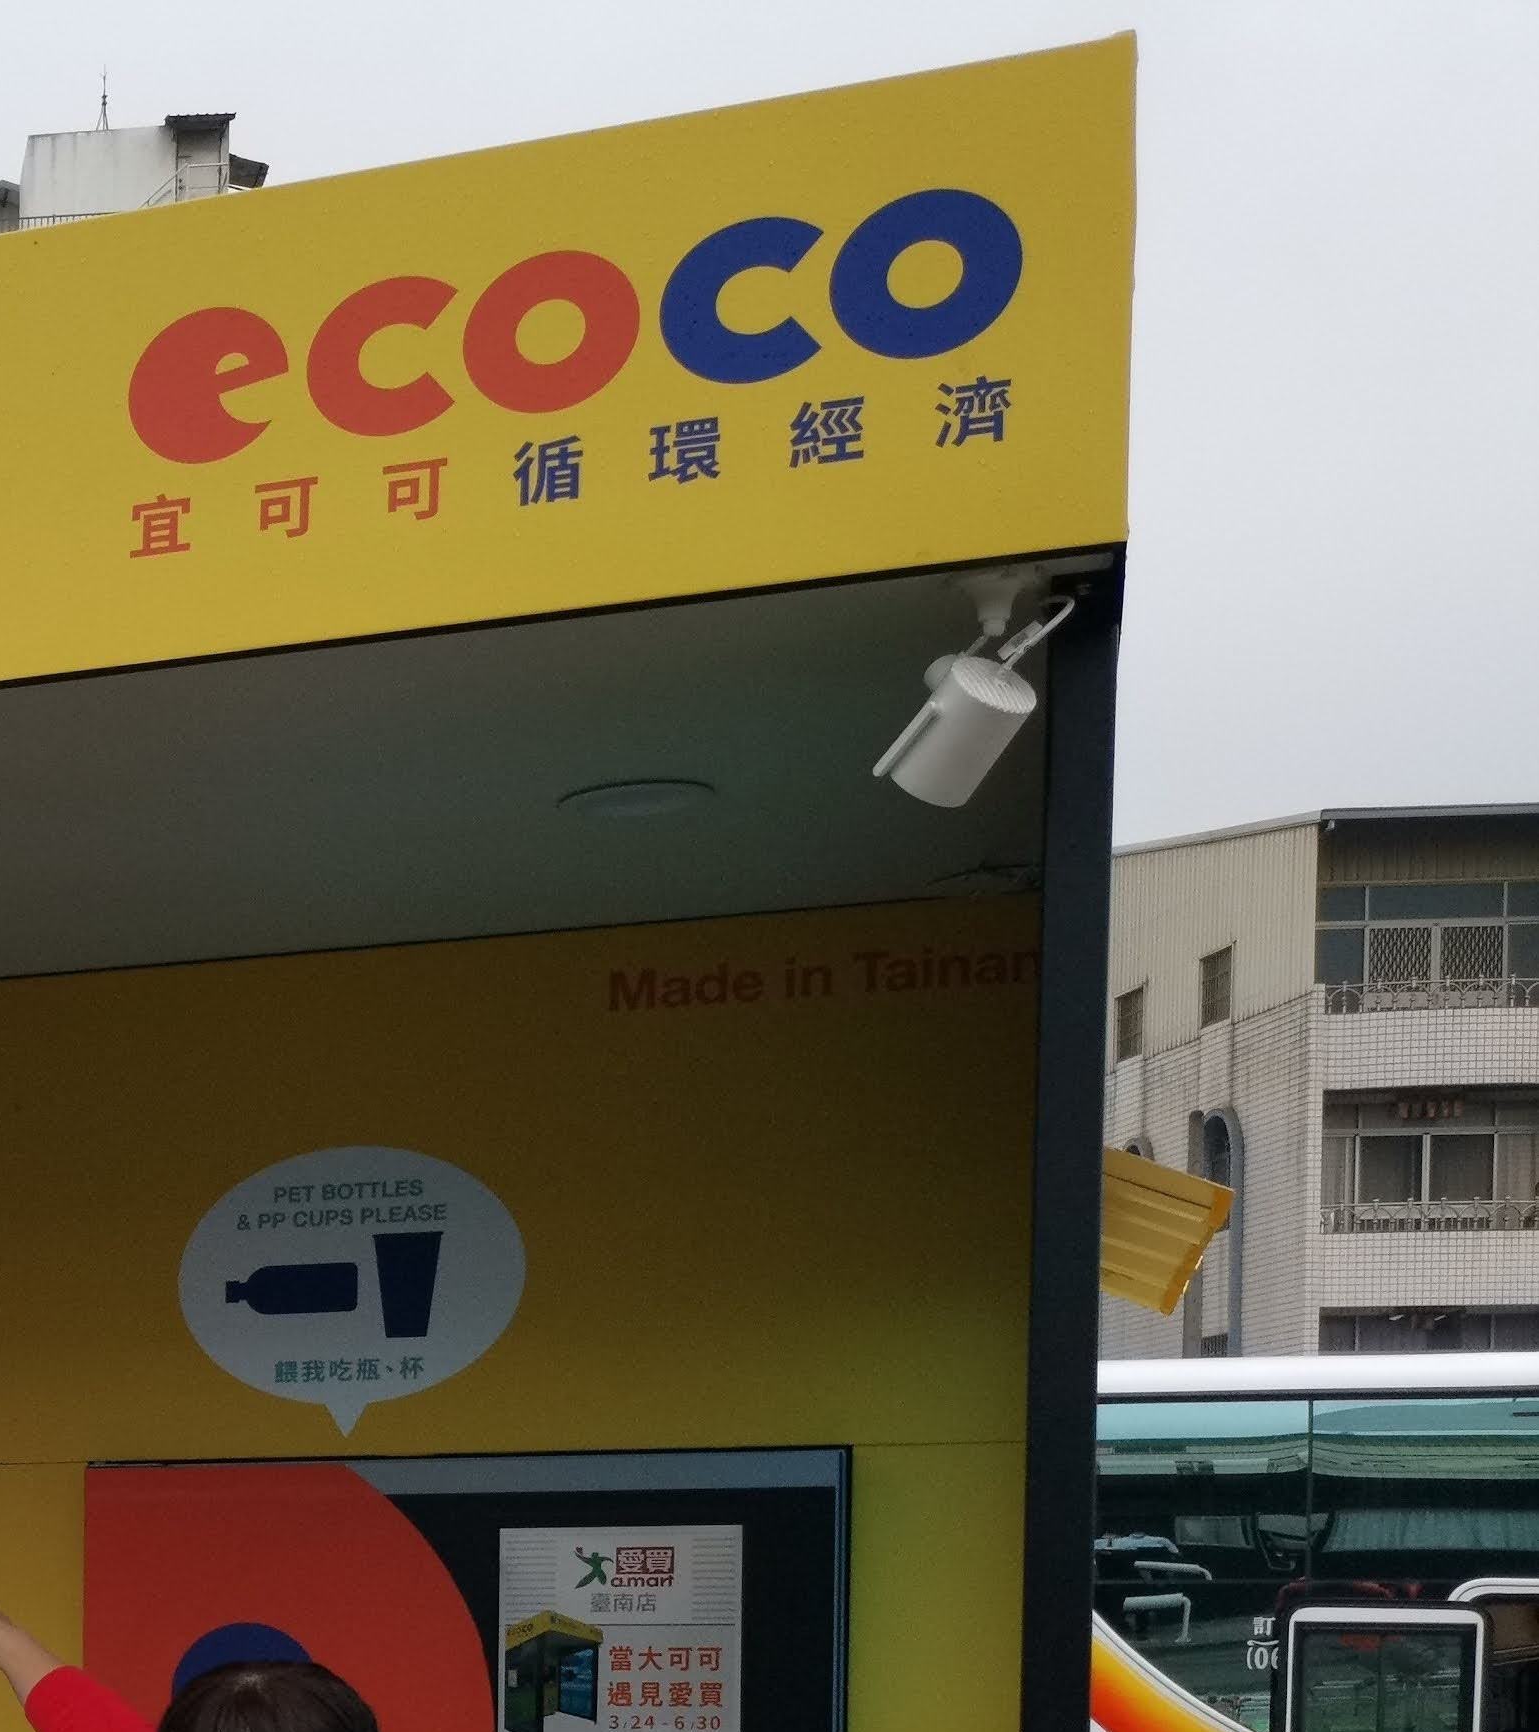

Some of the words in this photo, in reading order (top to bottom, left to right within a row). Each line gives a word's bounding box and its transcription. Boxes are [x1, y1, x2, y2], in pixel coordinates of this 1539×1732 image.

[128, 188, 1023, 465] ecoco
[129, 375, 1013, 559] 宜可可循環經濟
[608, 962, 763, 1011] Made
[784, 957, 834, 998] in
[273, 1184, 313, 1203] PET
[321, 1179, 424, 1201] BOTTLES
[236, 1213, 251, 1231] &
[258, 1211, 286, 1229] PP
[292, 1208, 354, 1228] CUPS
[360, 1203, 448, 1224] PLEASE
[274, 1356, 424, 1384] 餵我吃瓶、杯
[618, 1549, 673, 1573] 愛買
[590, 1593, 656, 1612] 臺南店
[609, 1646, 722, 1672] 當大可可
[608, 1681, 723, 1707] 遇見愛買
